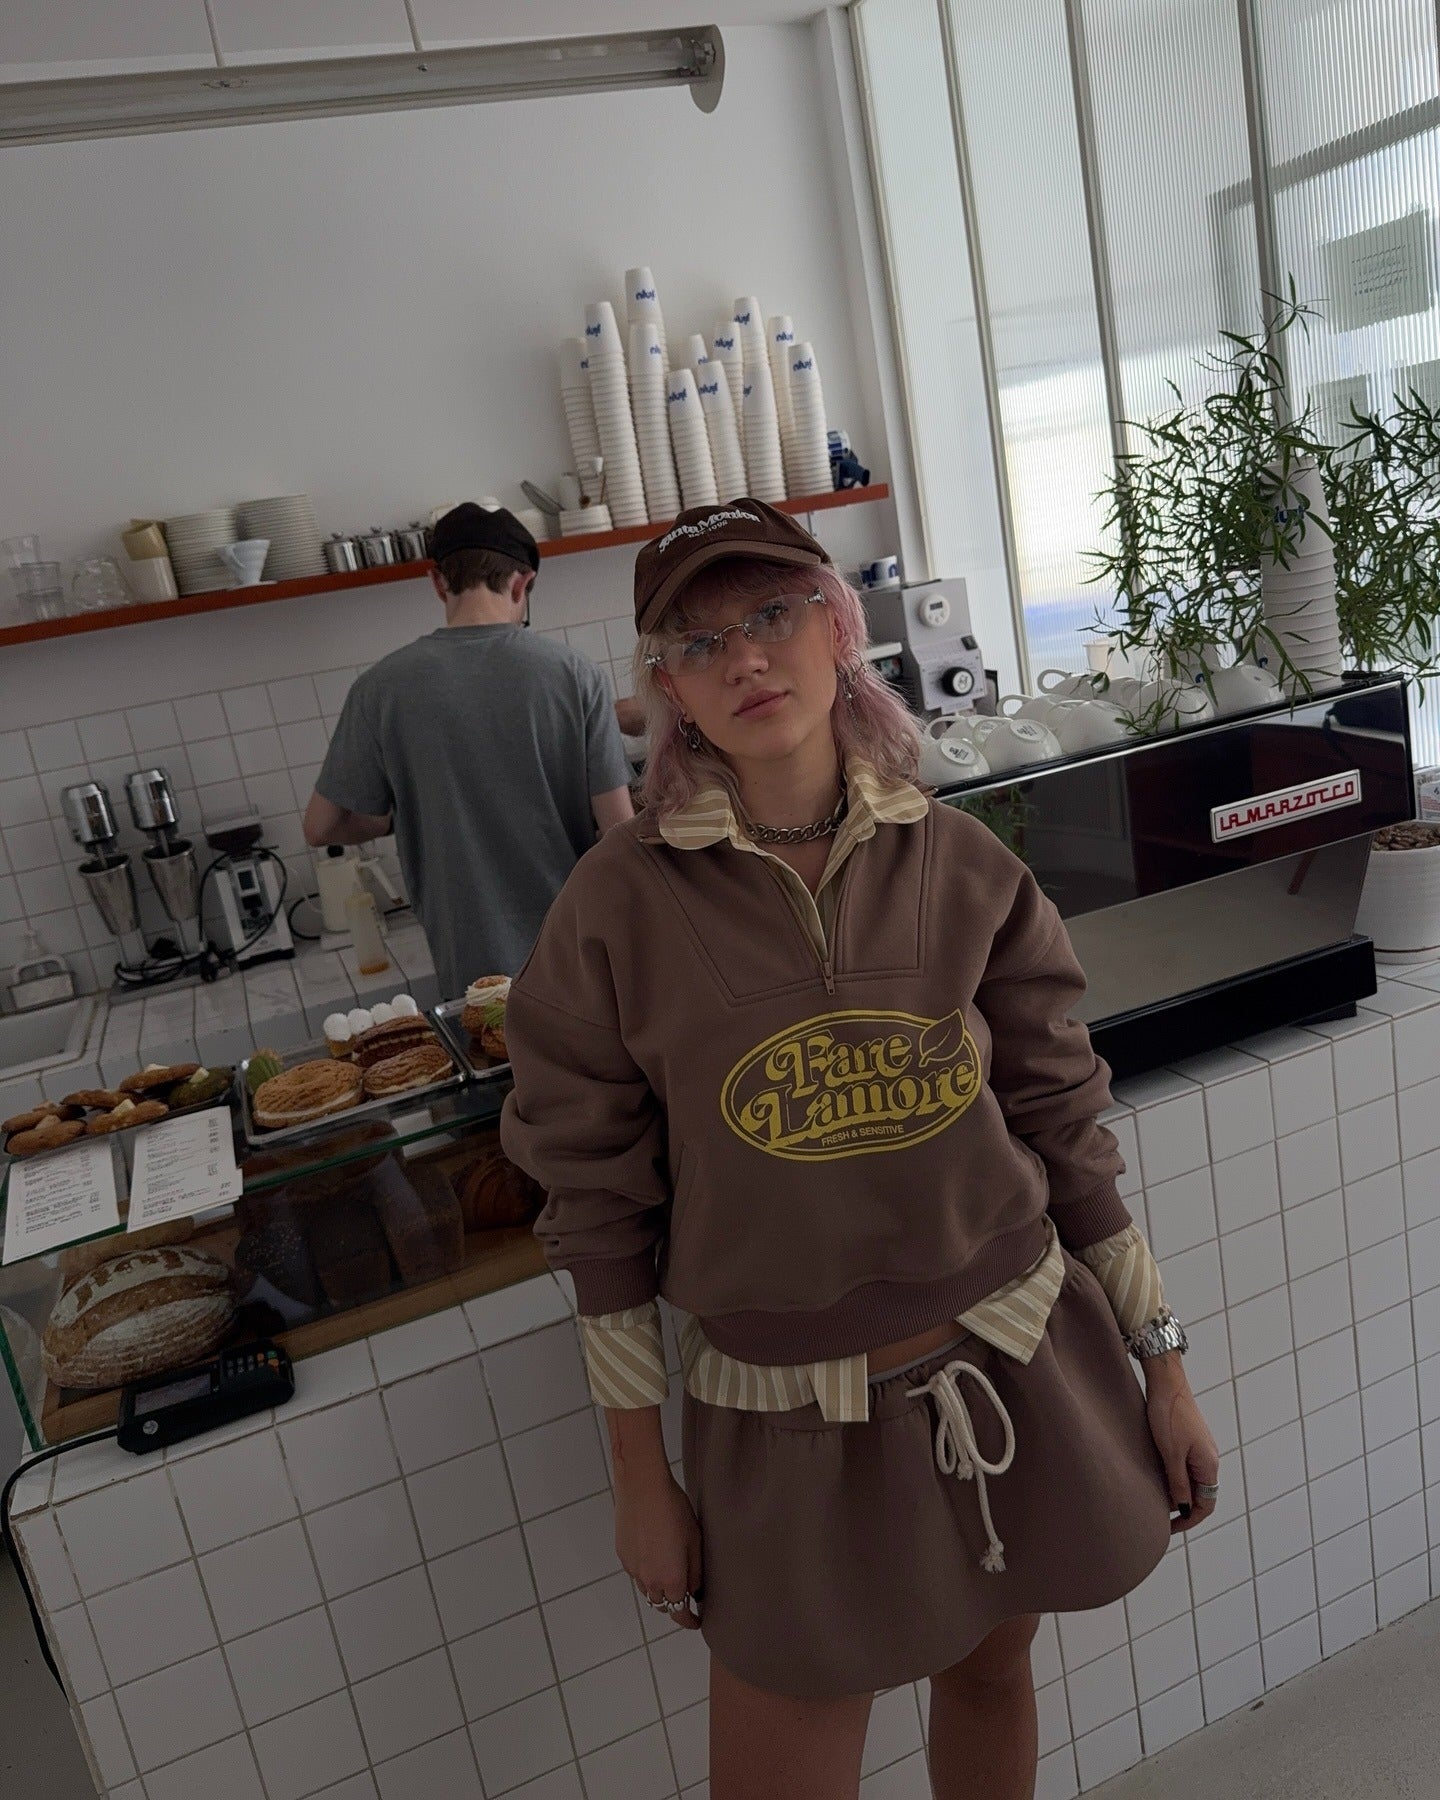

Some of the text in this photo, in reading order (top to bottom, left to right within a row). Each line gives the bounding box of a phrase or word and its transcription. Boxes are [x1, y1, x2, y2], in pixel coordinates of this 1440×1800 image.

[1219, 812, 1242, 832] LA
[765, 1029, 913, 1099] Fare
[740, 1060, 978, 1151] Lamore
[821, 1124, 905, 1147] FRESH & SENSITIVE
